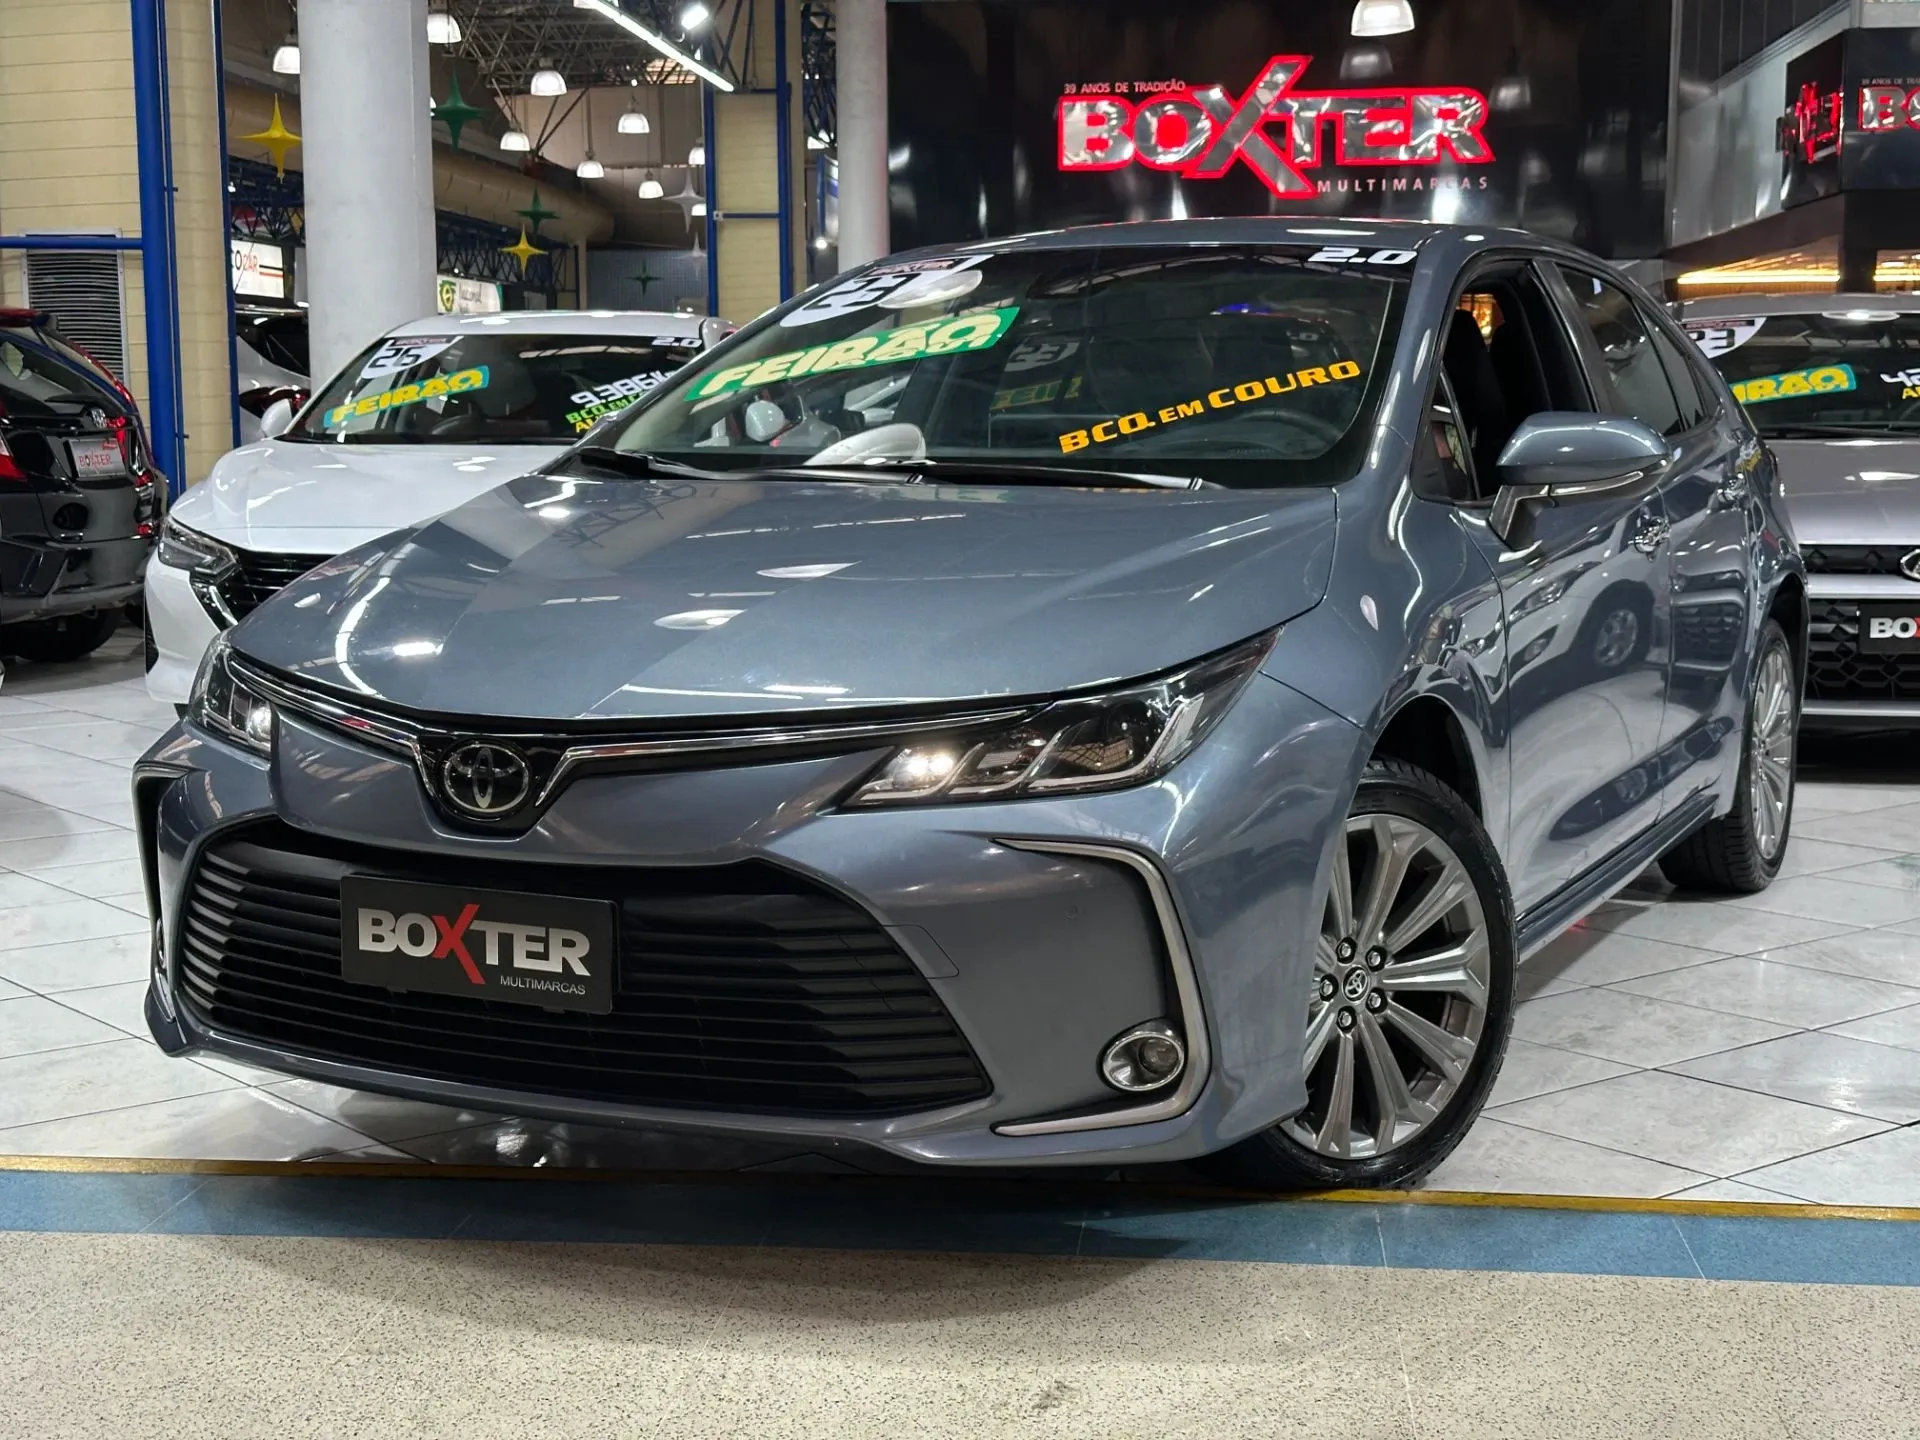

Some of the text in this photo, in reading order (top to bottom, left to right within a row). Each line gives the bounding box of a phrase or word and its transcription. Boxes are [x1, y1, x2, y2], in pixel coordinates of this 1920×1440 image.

[1064, 78, 1186, 94] 39 ANOS DE TRADIÇÃO
[1058, 55, 1496, 198] BOXTER
[1317, 176, 1488, 193] MULTIMARCAS
[1308, 247, 1418, 264] 2.0
[652, 336, 703, 348] 2.0
[699, 313, 1002, 395] FEIRÃO
[331, 369, 483, 423] FEIRÃO
[1158, 399, 1205, 424] EM
[1207, 360, 1361, 409] COURO
[1870, 616, 1920, 639] BO
[358, 903, 591, 985] BOXTER
[500, 974, 586, 995] MULTIMARCAS
